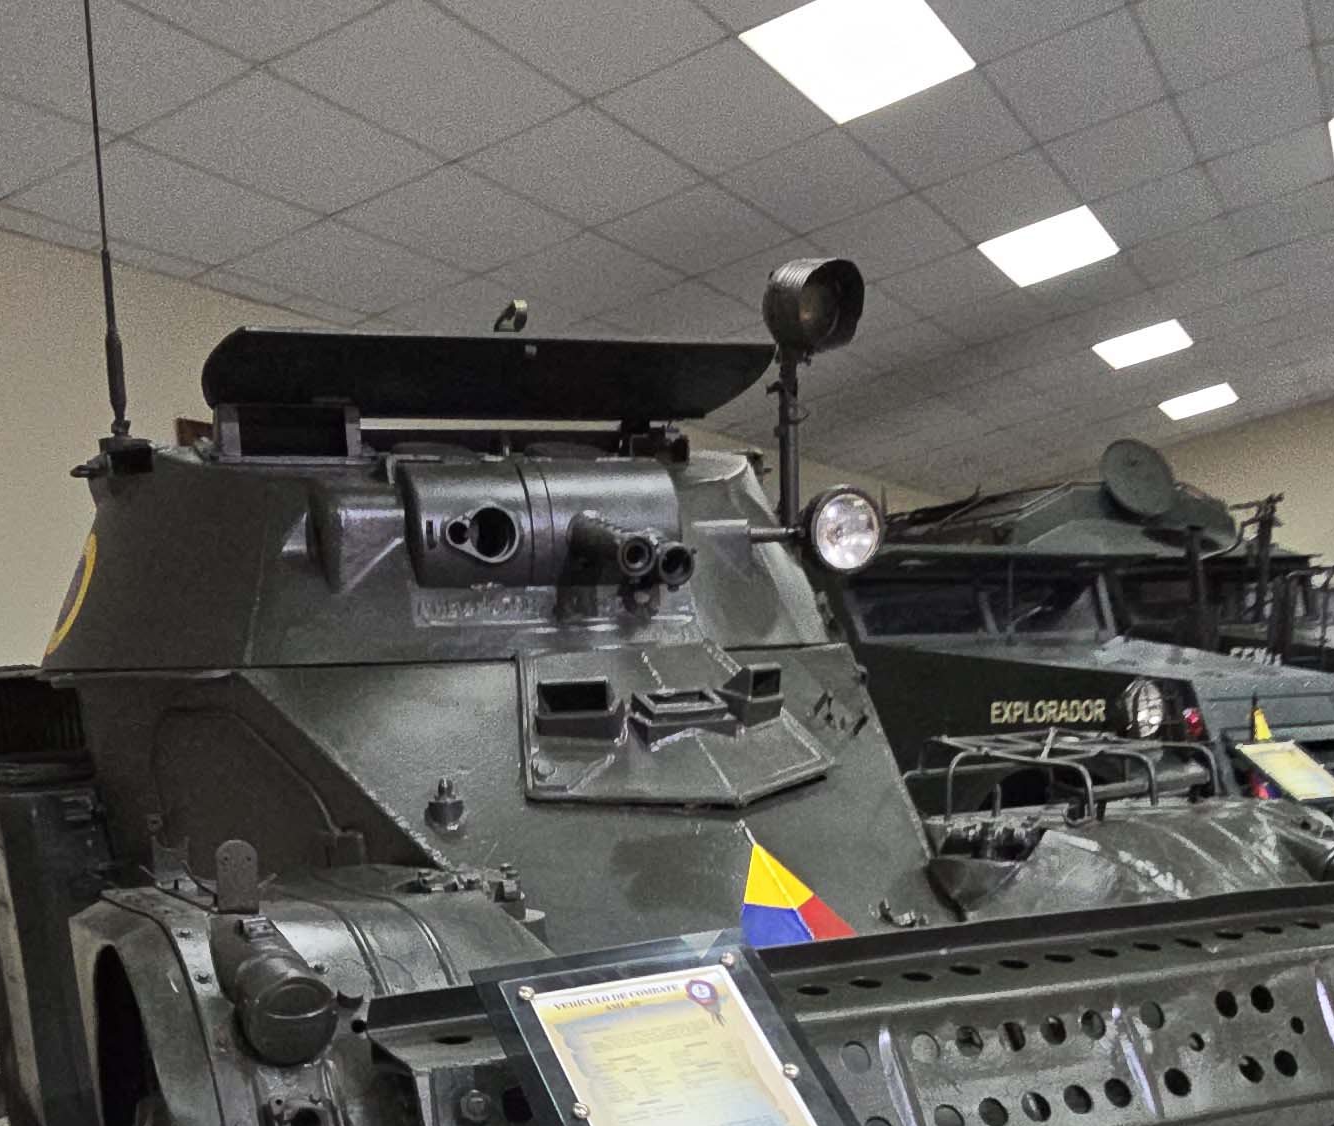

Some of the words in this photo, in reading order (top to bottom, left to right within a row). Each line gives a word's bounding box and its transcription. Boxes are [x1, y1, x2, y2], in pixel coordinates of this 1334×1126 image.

[990, 699, 1106, 724] EXPLORADOR
[611, 991, 628, 1002] DE
[629, 984, 680, 1000] COMBATE
